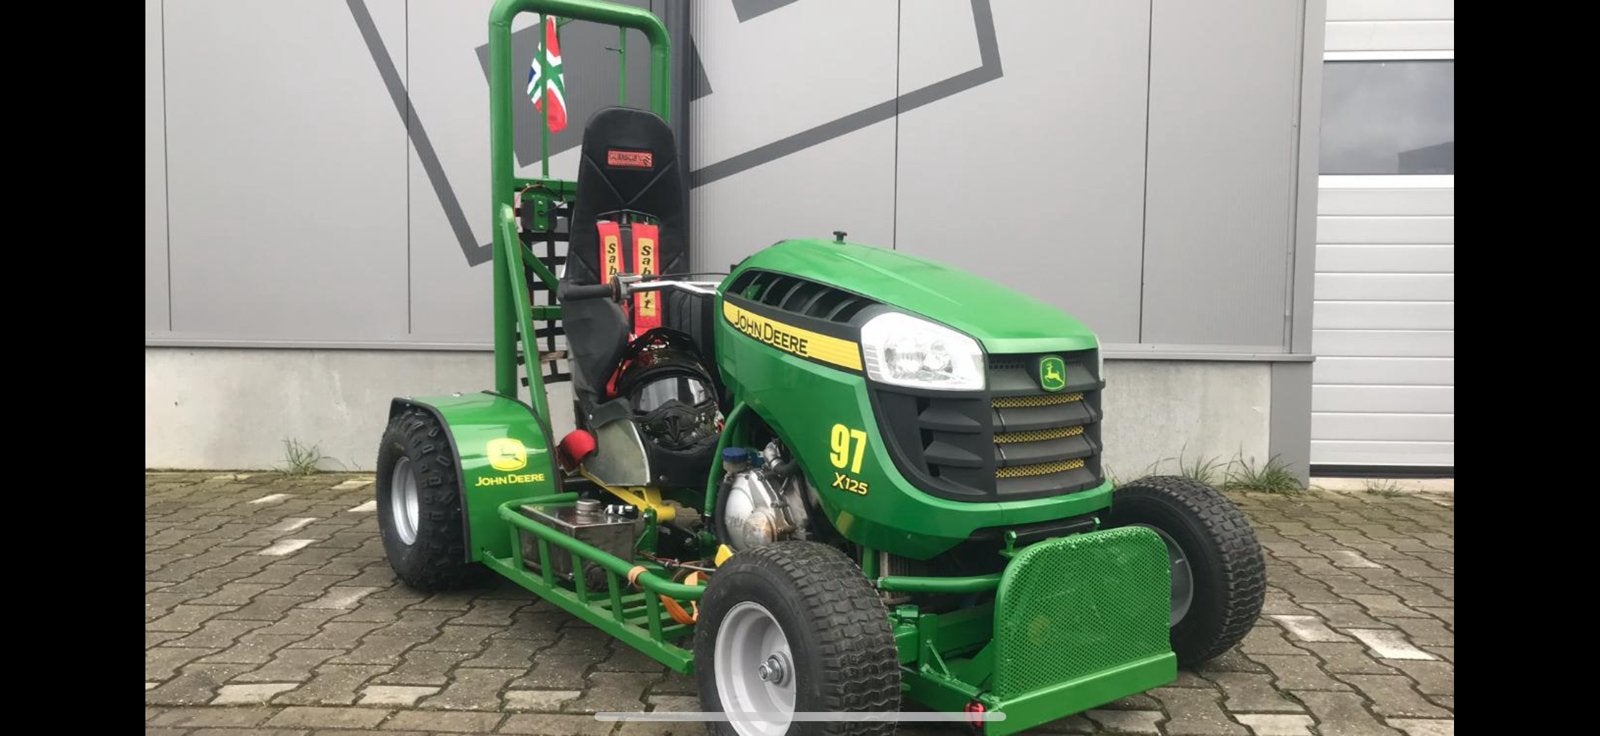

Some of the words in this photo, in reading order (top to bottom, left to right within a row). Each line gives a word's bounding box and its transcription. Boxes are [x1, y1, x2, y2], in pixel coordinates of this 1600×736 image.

[608, 243, 617, 276] Sab
[641, 245, 652, 309] Sablt
[734, 310, 762, 338] JOHN
[763, 323, 808, 354] DEERE
[830, 423, 867, 474] 97
[475, 476, 507, 487] JOHN
[508, 473, 545, 484] DEERE
[832, 471, 868, 495] X125
